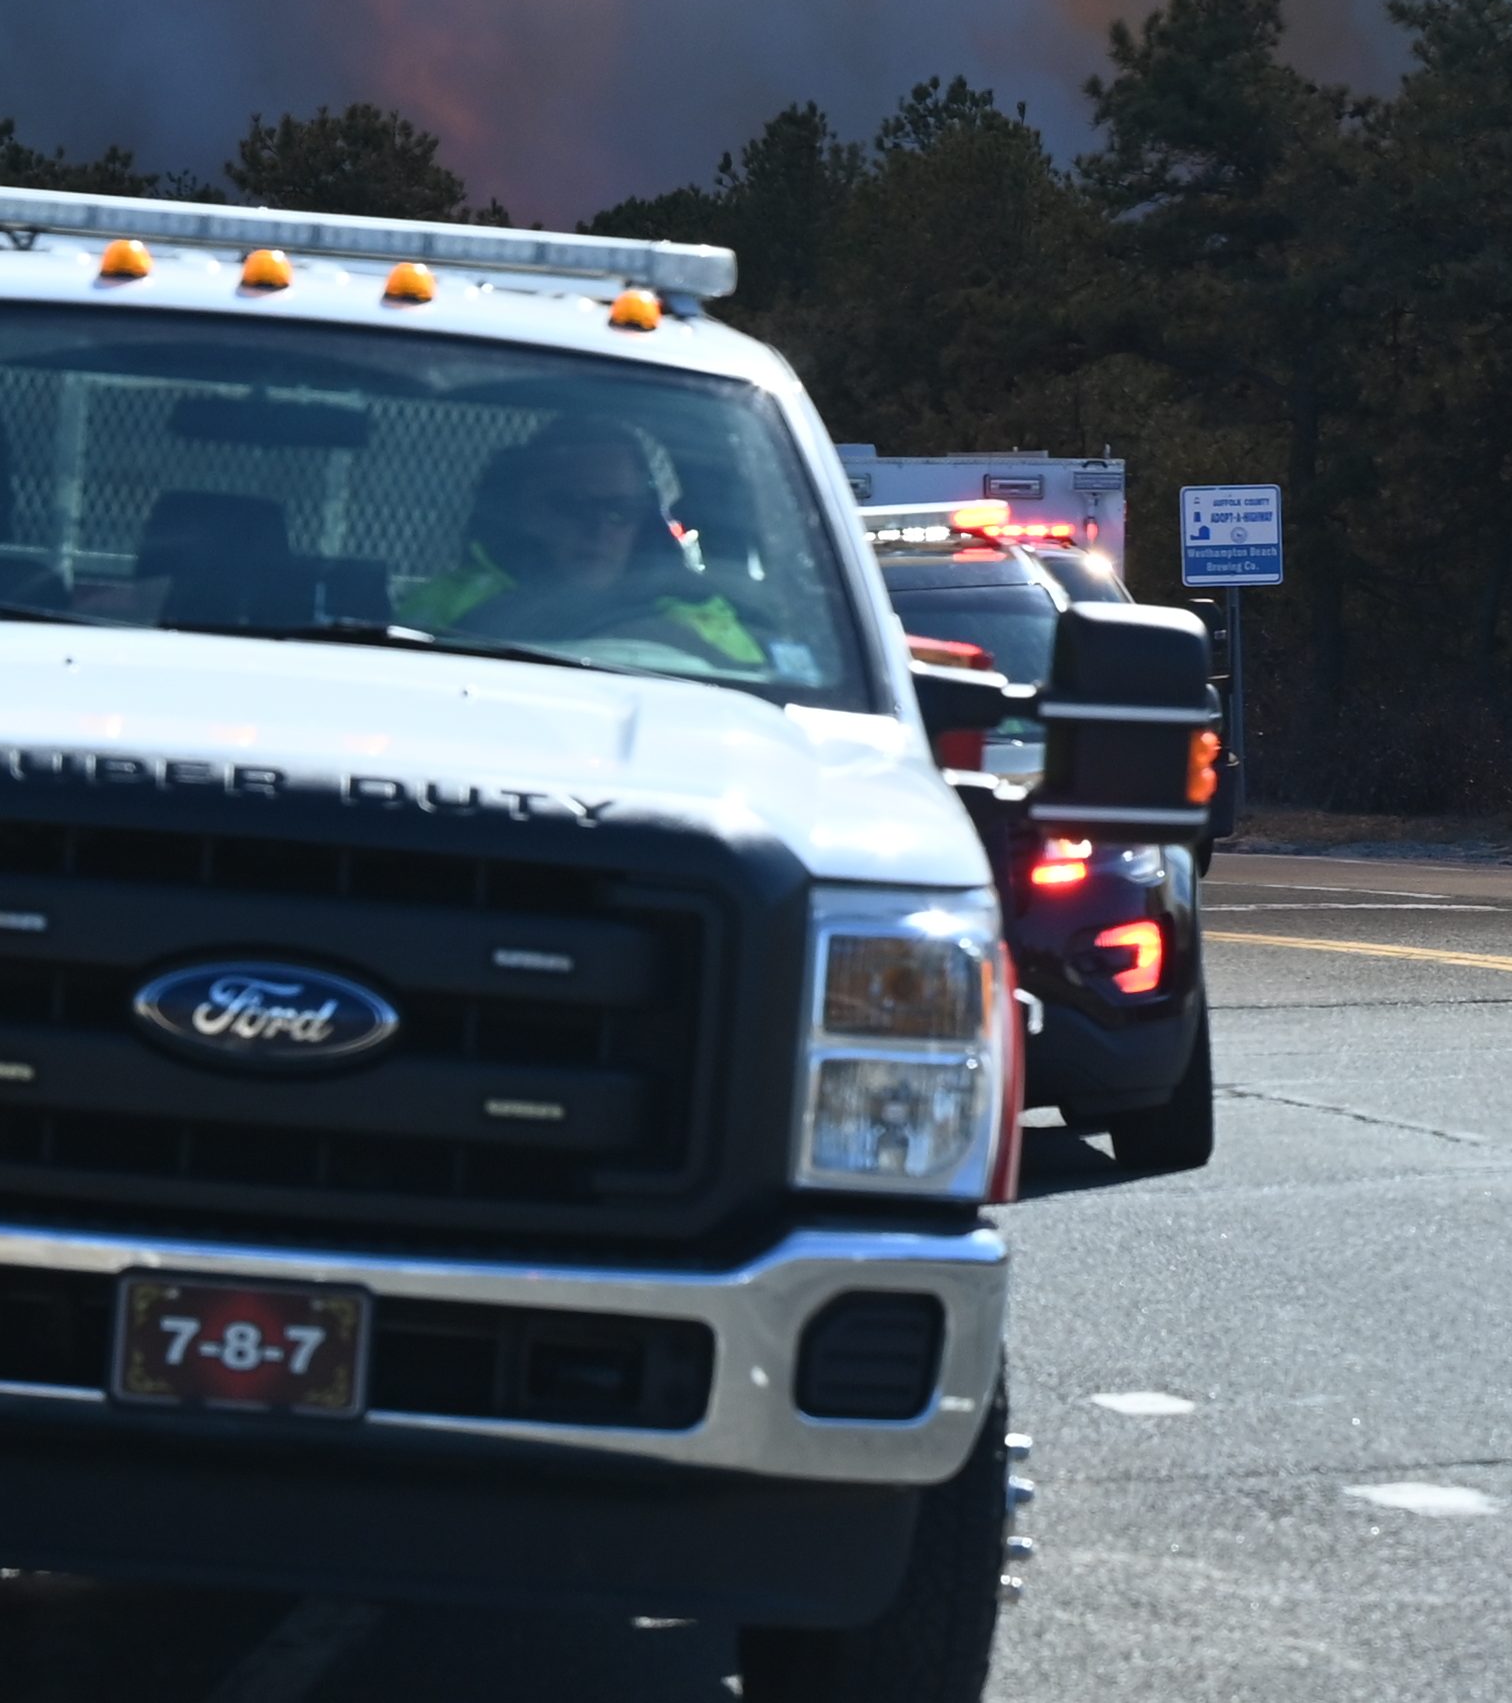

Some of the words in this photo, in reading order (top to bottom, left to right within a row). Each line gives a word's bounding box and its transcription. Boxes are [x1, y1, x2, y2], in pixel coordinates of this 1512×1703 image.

[1187, 548, 1248, 559] Westhampton
[1250, 546, 1277, 556] Beach
[1206, 562, 1243, 573] Brewing
[339, 773, 614, 828] DUTY
[192, 975, 340, 1042] Ford
[160, 1316, 326, 1374] 7-8-7
